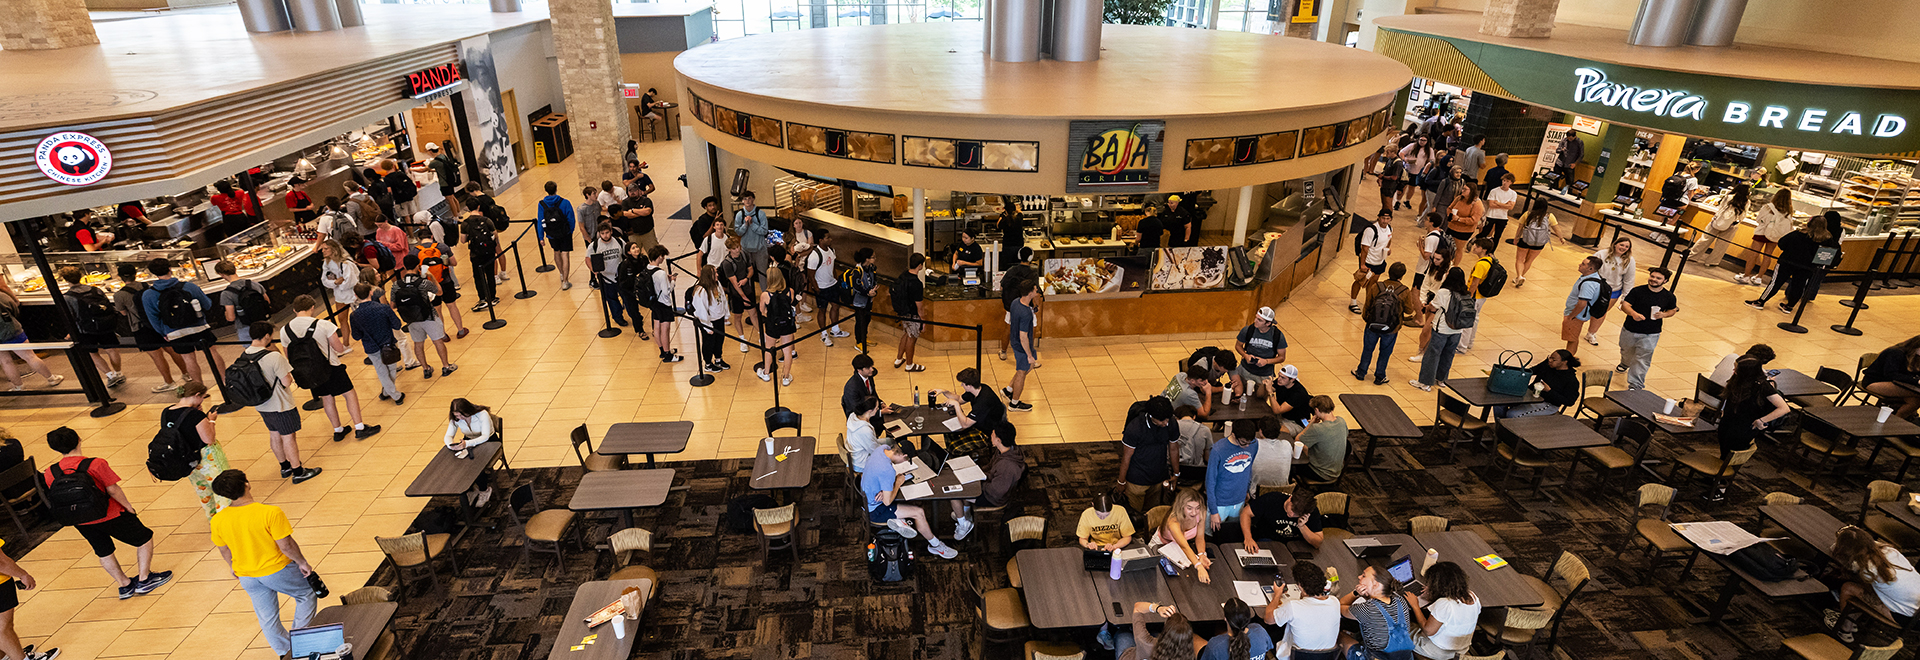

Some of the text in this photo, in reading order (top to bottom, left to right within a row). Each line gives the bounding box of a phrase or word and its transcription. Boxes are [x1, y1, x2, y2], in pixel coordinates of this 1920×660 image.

[409, 62, 462, 95] PANDA
[424, 88, 454, 103] EXPRESS
[624, 88, 636, 97] EXIT
[1574, 67, 1907, 138] Panera BREAD
[38, 133, 106, 161] PANDA EXPRESS
[1083, 123, 1150, 175] BAJA
[47, 161, 108, 183] CHINESE KITCHEN
[1083, 174, 1143, 183] GRILL
